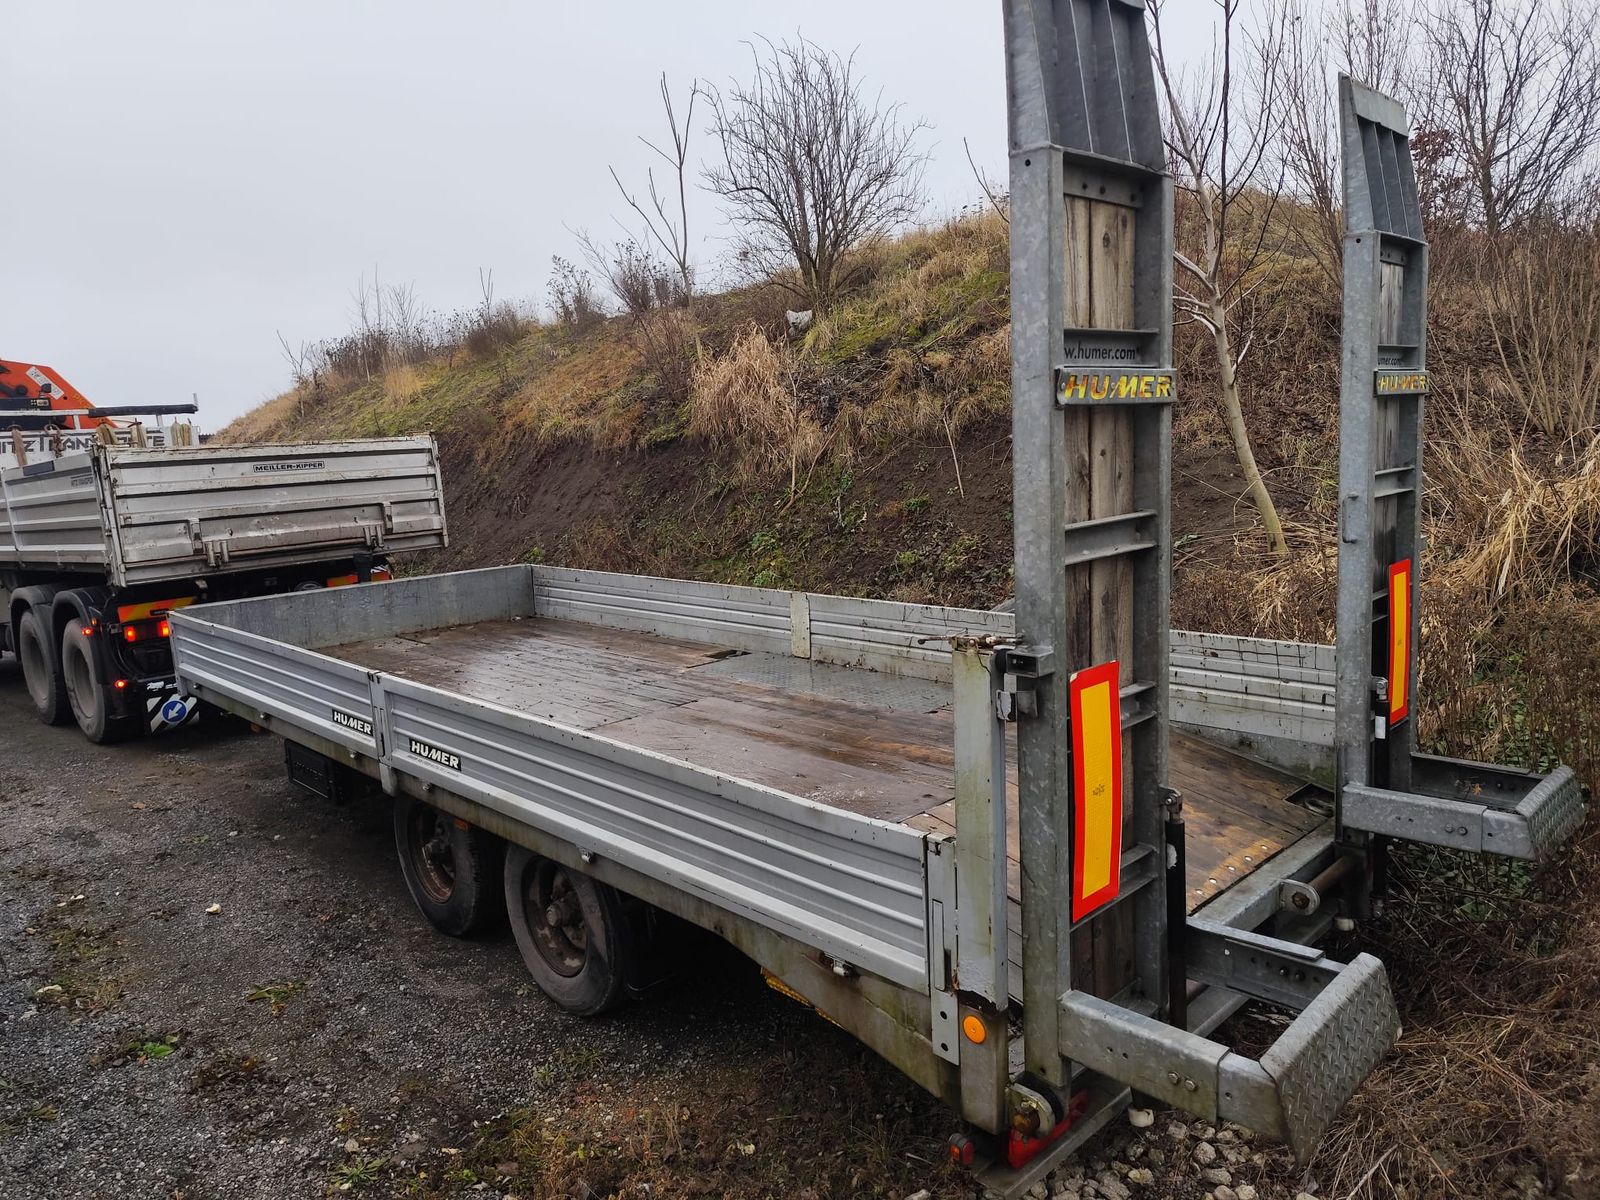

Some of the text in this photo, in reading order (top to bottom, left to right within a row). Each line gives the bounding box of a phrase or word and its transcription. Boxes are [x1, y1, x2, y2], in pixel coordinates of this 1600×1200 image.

[1064, 374, 1173, 400] HUMER
[1379, 375, 1428, 391] HUMER
[255, 462, 323, 472] MEILLER-KIPPER
[333, 711, 373, 735] HUMER
[411, 741, 460, 769] HUMER
